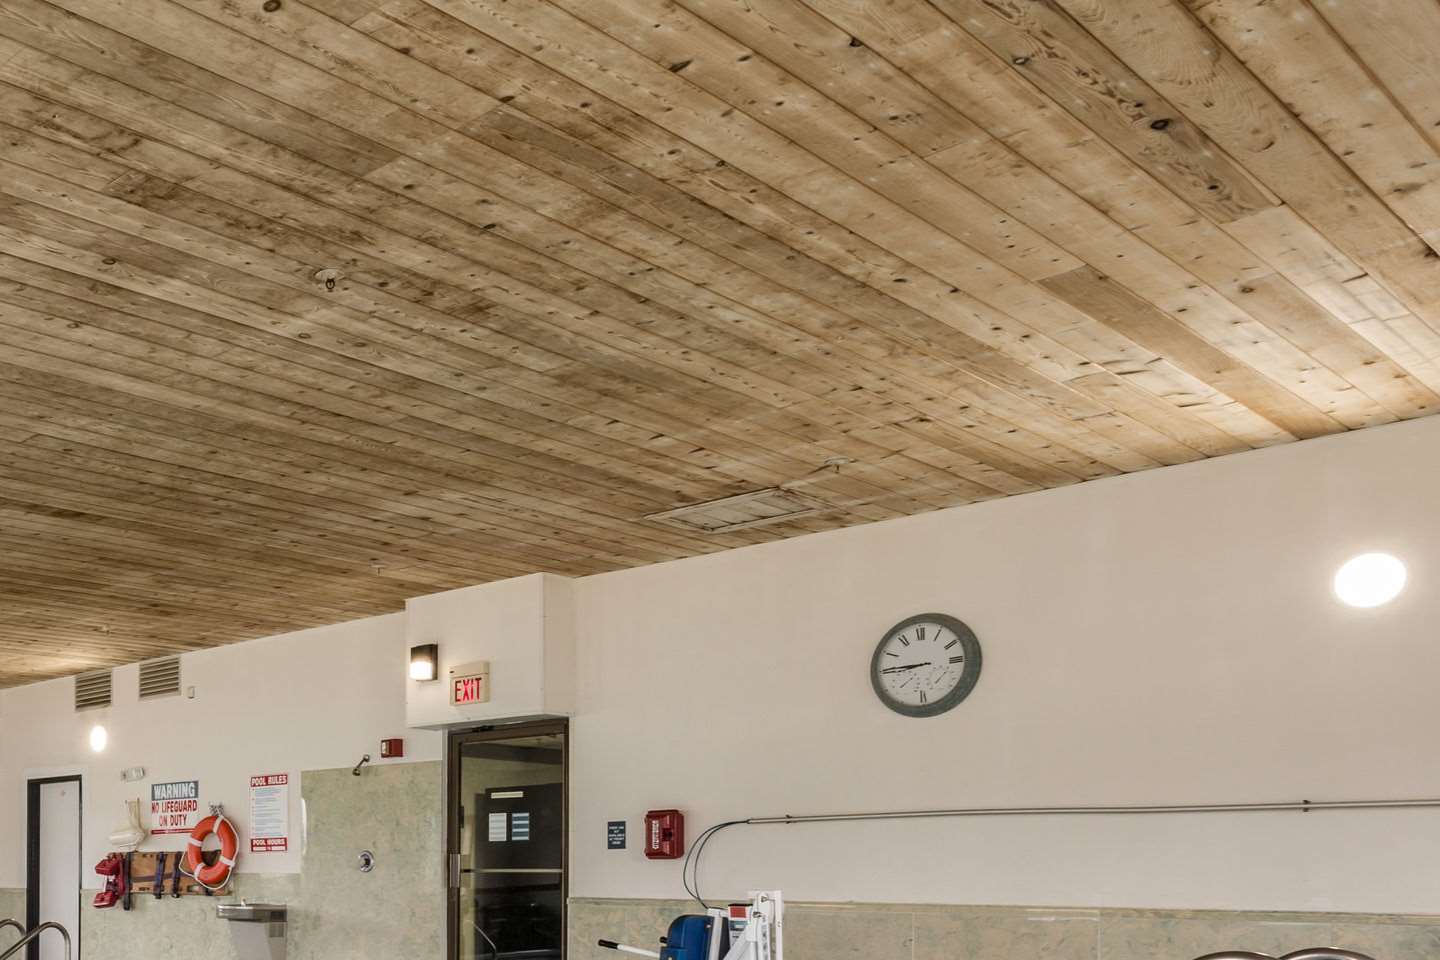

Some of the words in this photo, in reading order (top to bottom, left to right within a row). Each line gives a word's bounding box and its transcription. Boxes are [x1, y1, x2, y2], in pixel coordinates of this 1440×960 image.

[455, 677, 482, 702] EXIT
[153, 783, 195, 800] WARNING
[162, 799, 198, 813] LIFEGUARD
[170, 814, 187, 826] DUTY
